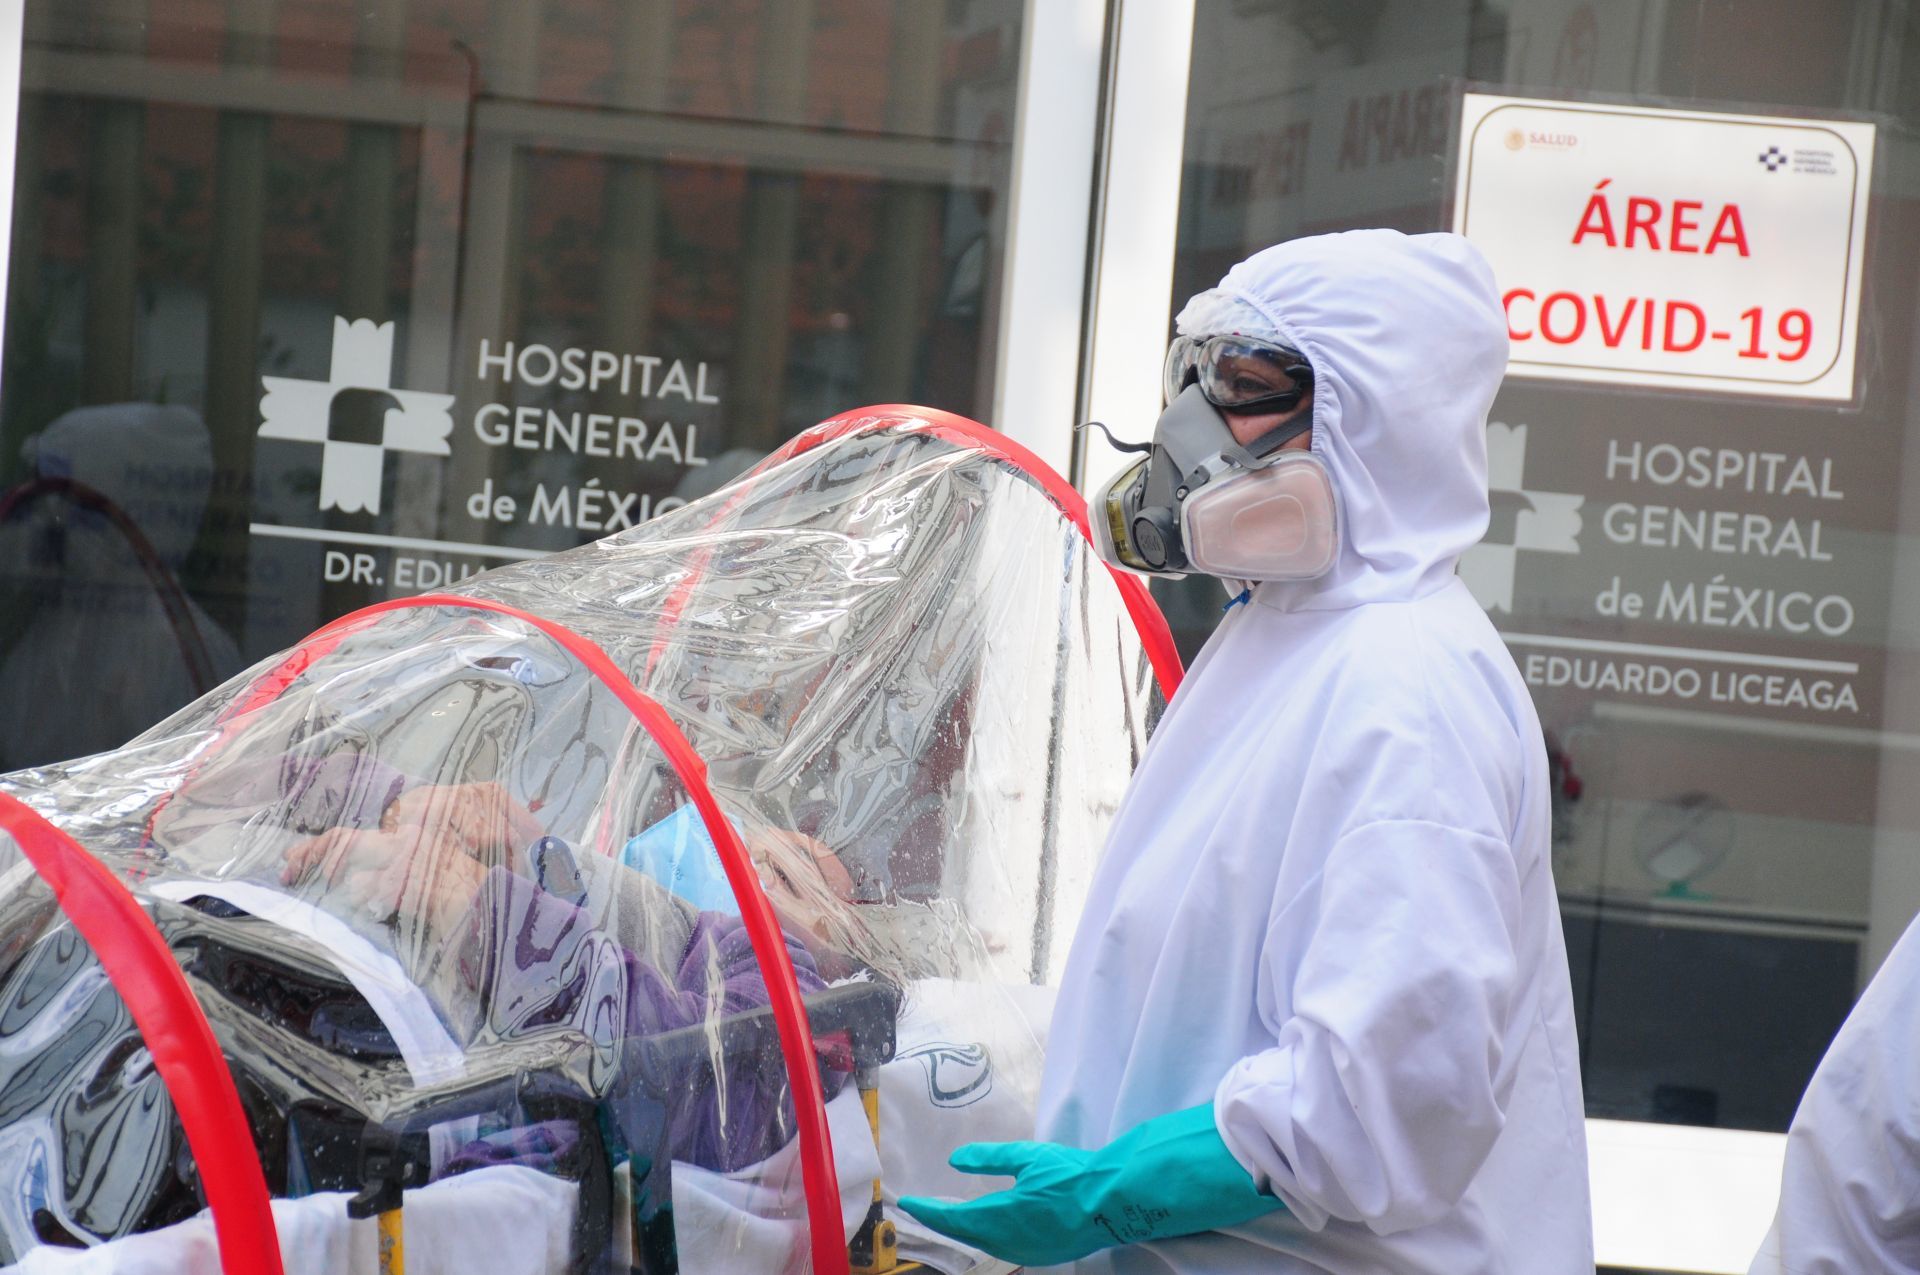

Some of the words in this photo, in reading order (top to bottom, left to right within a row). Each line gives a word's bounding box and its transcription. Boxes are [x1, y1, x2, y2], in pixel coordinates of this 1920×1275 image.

[1530, 131, 1578, 146] SALUD
[1571, 178, 1750, 258] ÁREA
[1502, 287, 1814, 362] COVID-19
[477, 338, 719, 404] HOSPITAL
[474, 403, 708, 466] GENERAL
[1606, 439, 1844, 499] HOSPITAL
[466, 478, 517, 521] de
[1603, 502, 1833, 561] GENERAL
[324, 550, 384, 586] DR.
[393, 557, 488, 590] EDU
[1595, 576, 1643, 618] de
[1656, 574, 1855, 636] MÉXICO
[1525, 654, 1701, 698] EDUARDO
[1710, 671, 1859, 713] LICEAGA
